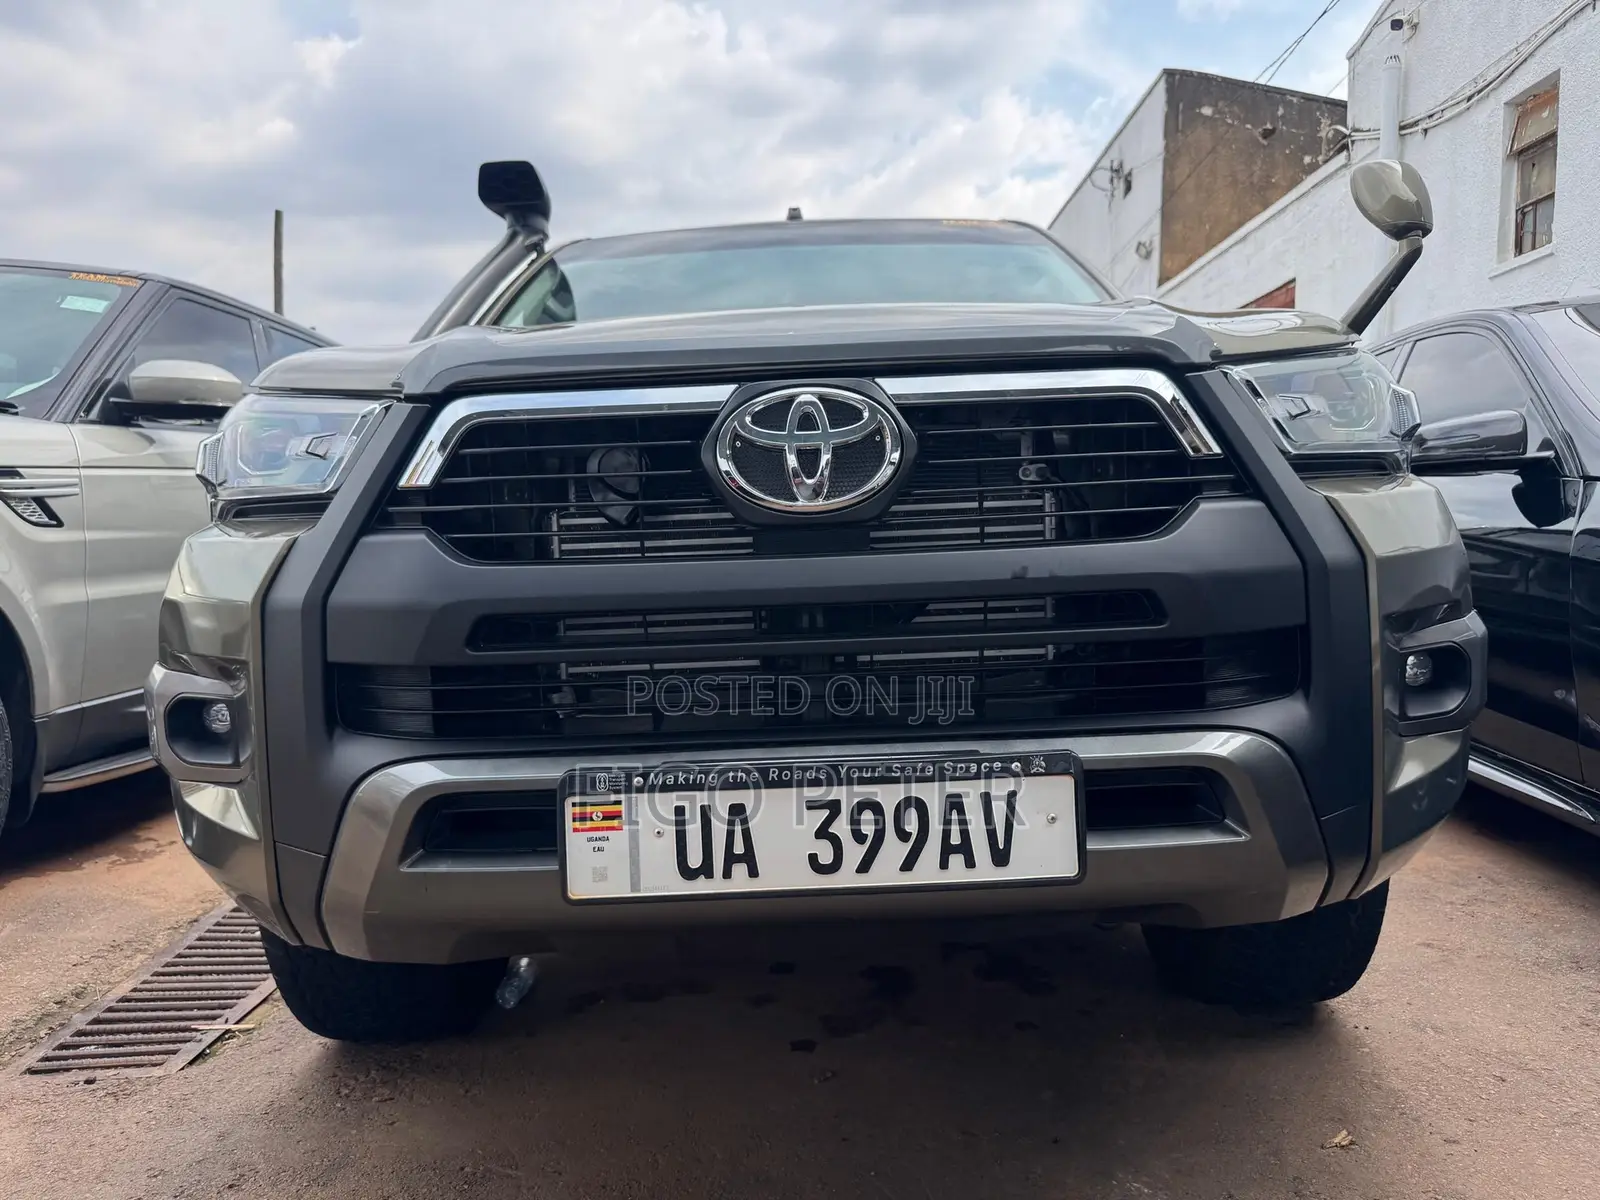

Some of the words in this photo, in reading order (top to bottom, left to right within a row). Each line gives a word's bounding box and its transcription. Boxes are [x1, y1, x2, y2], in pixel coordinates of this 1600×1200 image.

[649, 771, 719, 787] Making
[728, 769, 759, 784] the
[768, 766, 828, 782] Roads
[838, 764, 883, 778] Your
[891, 762, 935, 777] Safe
[943, 761, 1002, 777] Space
[673, 802, 760, 881] UA
[805, 789, 1018, 875] 399AV
